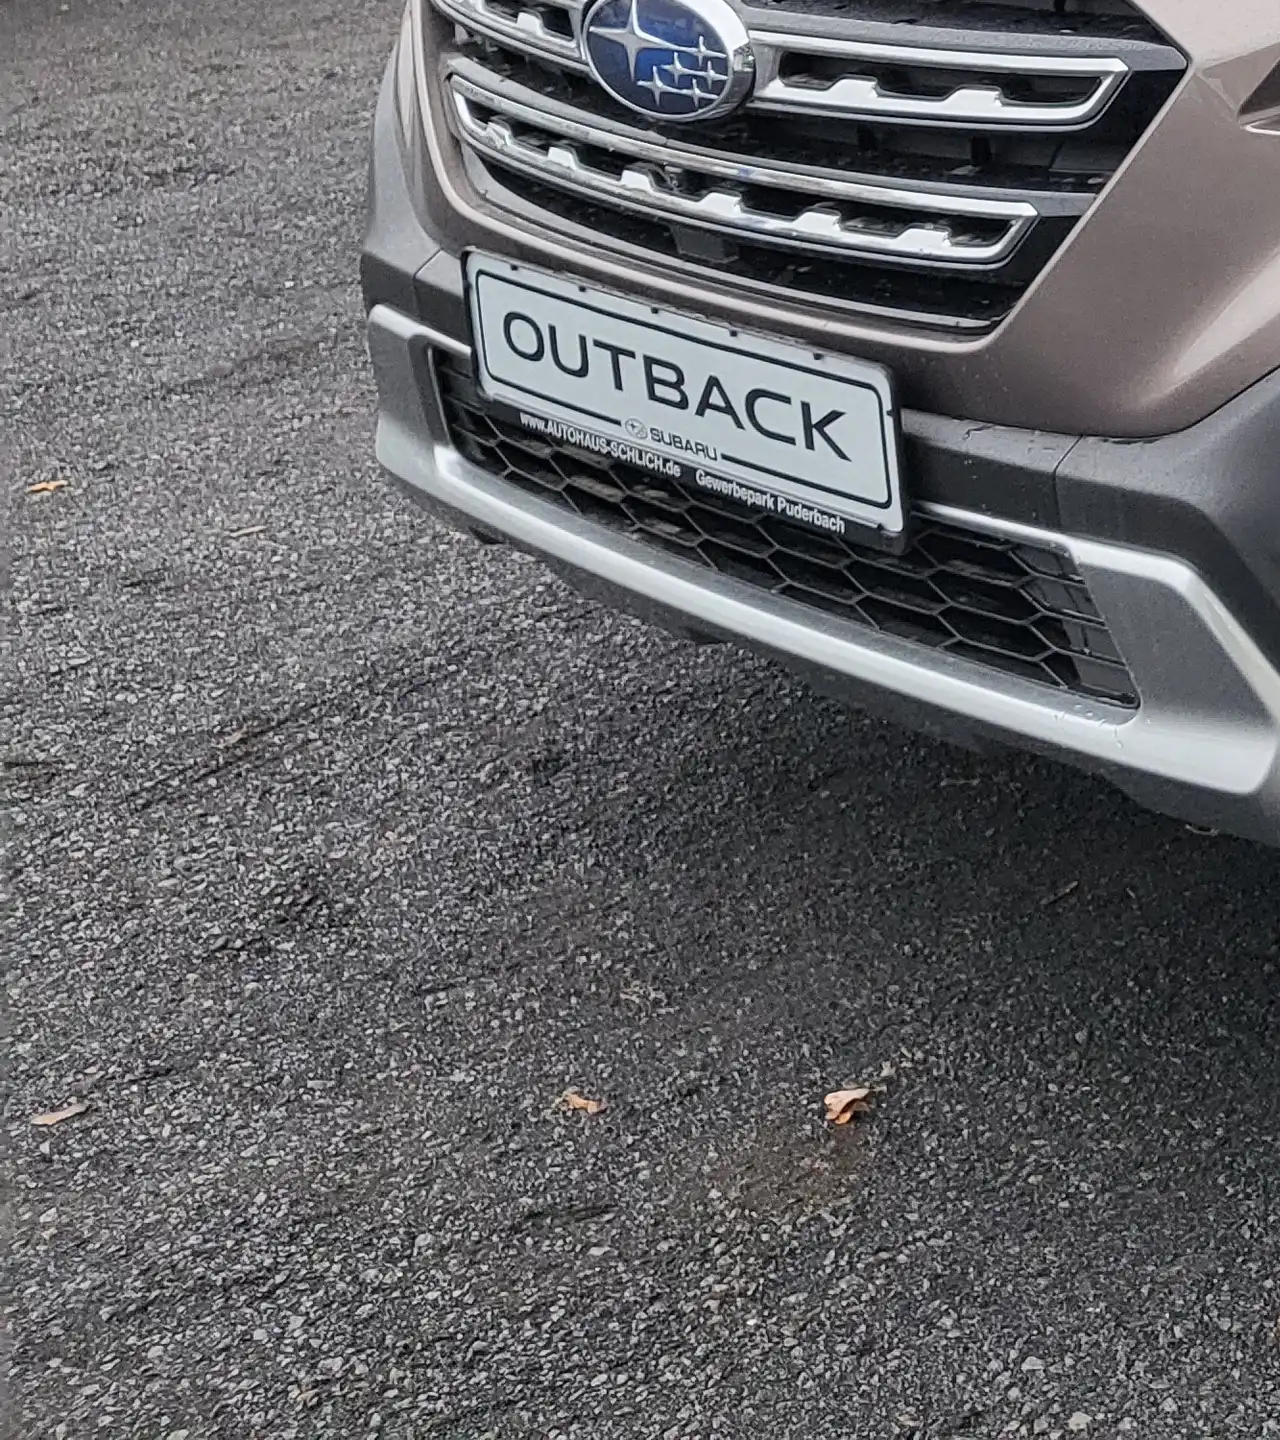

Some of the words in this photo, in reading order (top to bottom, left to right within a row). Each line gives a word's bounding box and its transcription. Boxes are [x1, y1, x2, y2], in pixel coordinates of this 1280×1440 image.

[502, 311, 853, 462] OUTBACK
[650, 426, 718, 461] SUBARU
[519, 412, 682, 478] www.AUTOHAUS-SCHLICH.de
[695, 469, 775, 511] Gewerbepark
[776, 495, 846, 534] Puderbach
